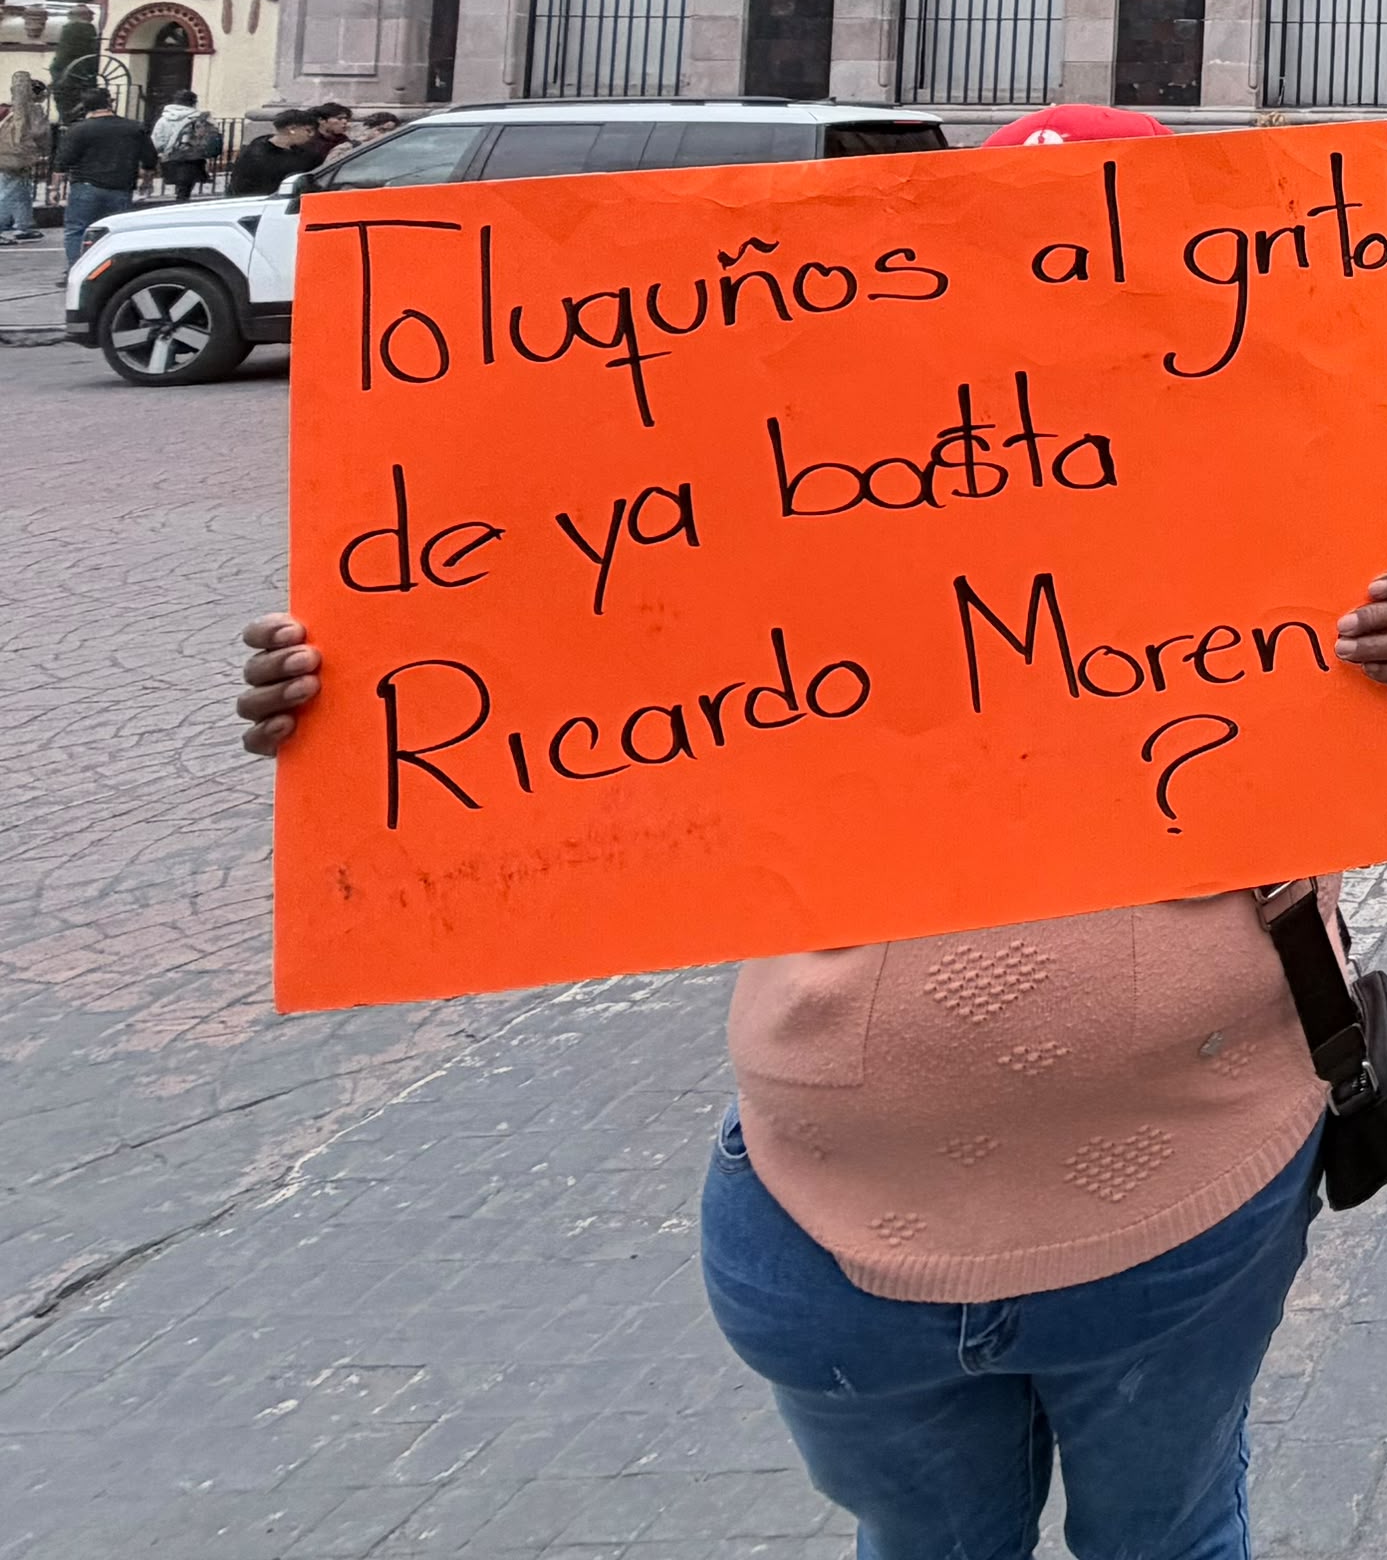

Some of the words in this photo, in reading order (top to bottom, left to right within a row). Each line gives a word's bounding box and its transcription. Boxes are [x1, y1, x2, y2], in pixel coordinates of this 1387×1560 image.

[304, 219, 950, 428] Toluquños
[1032, 161, 1125, 285] al
[339, 464, 504, 593] de
[555, 481, 701, 616] ya
[376, 627, 872, 831] Ricardo
[1140, 713, 1238, 835] ?
